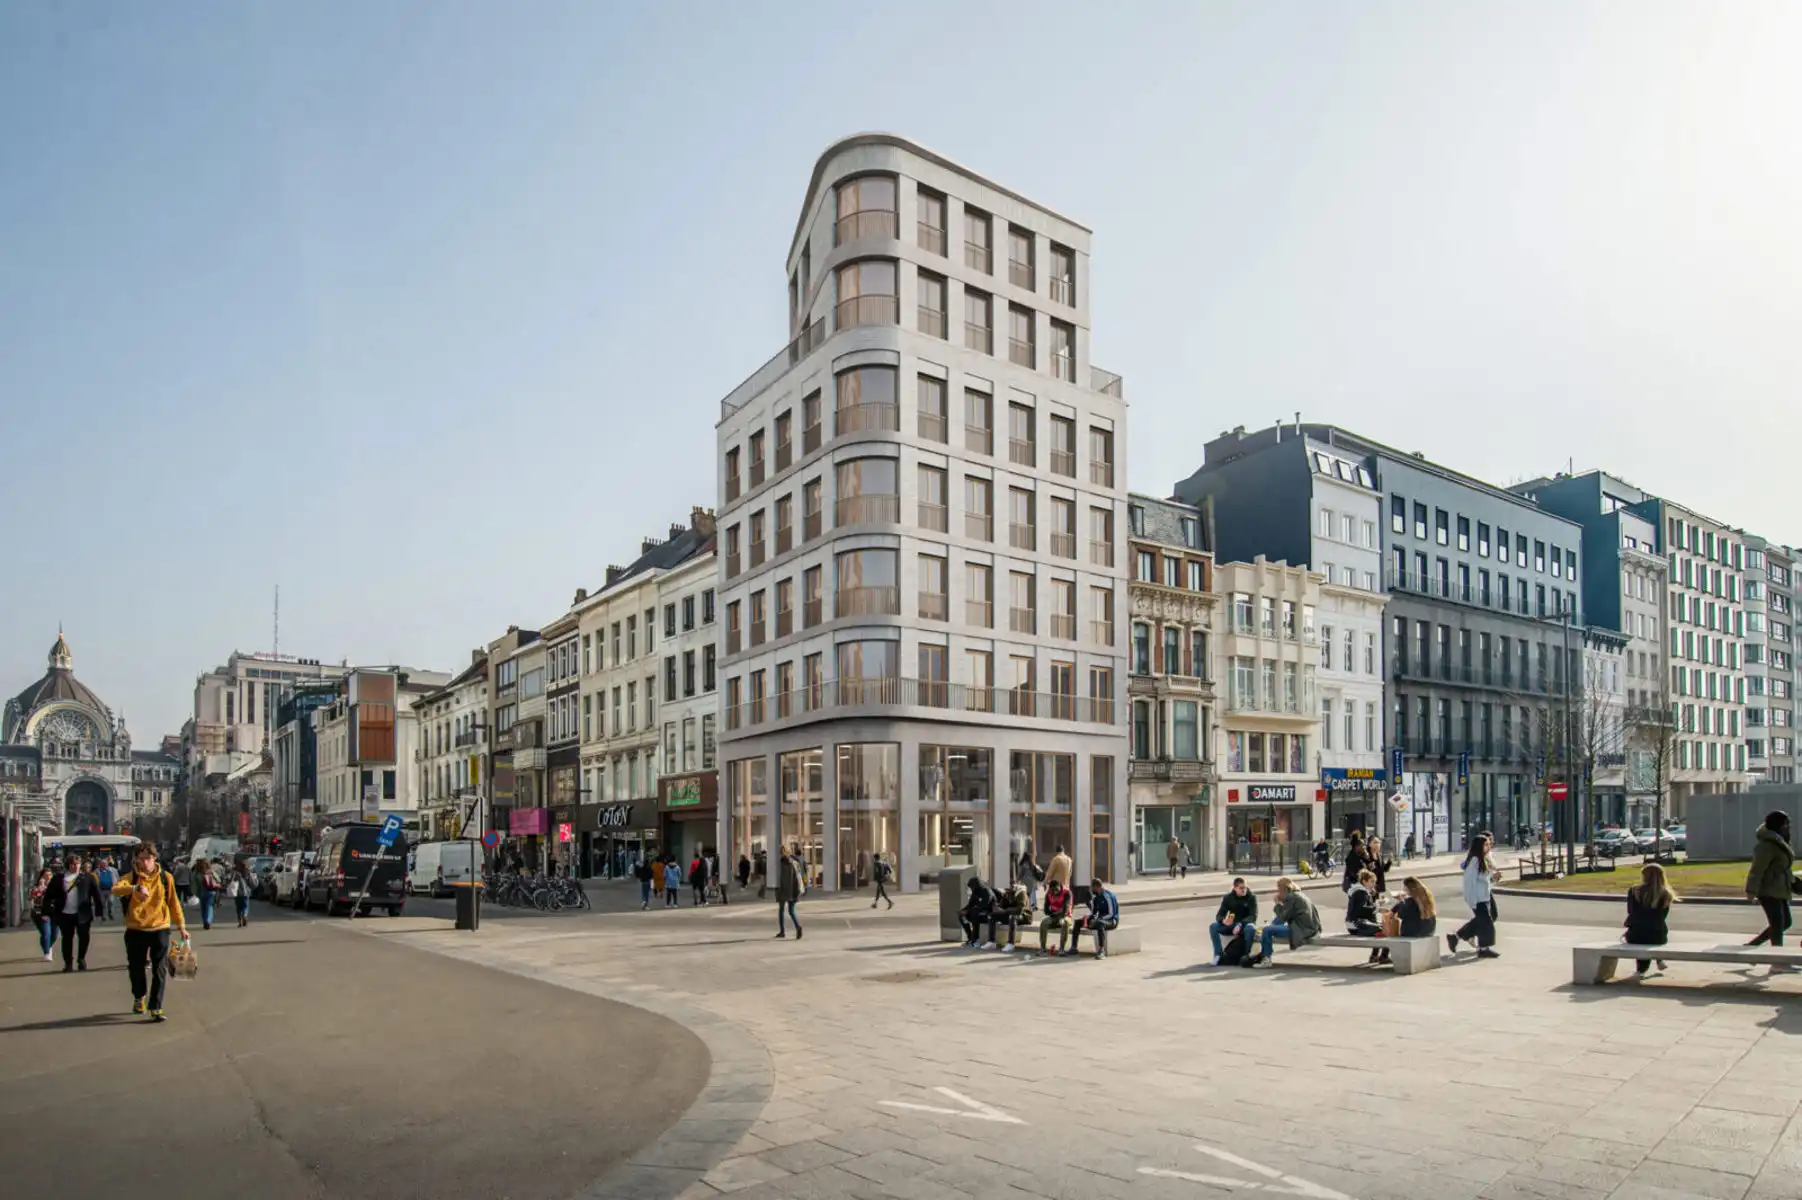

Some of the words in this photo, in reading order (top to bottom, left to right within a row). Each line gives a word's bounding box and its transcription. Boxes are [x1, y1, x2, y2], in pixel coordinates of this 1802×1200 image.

[1332, 779, 1361, 790] CARPET
[1362, 780, 1387, 790] WORLD
[1252, 787, 1295, 799] DAMART
[384, 819, 399, 834] P
